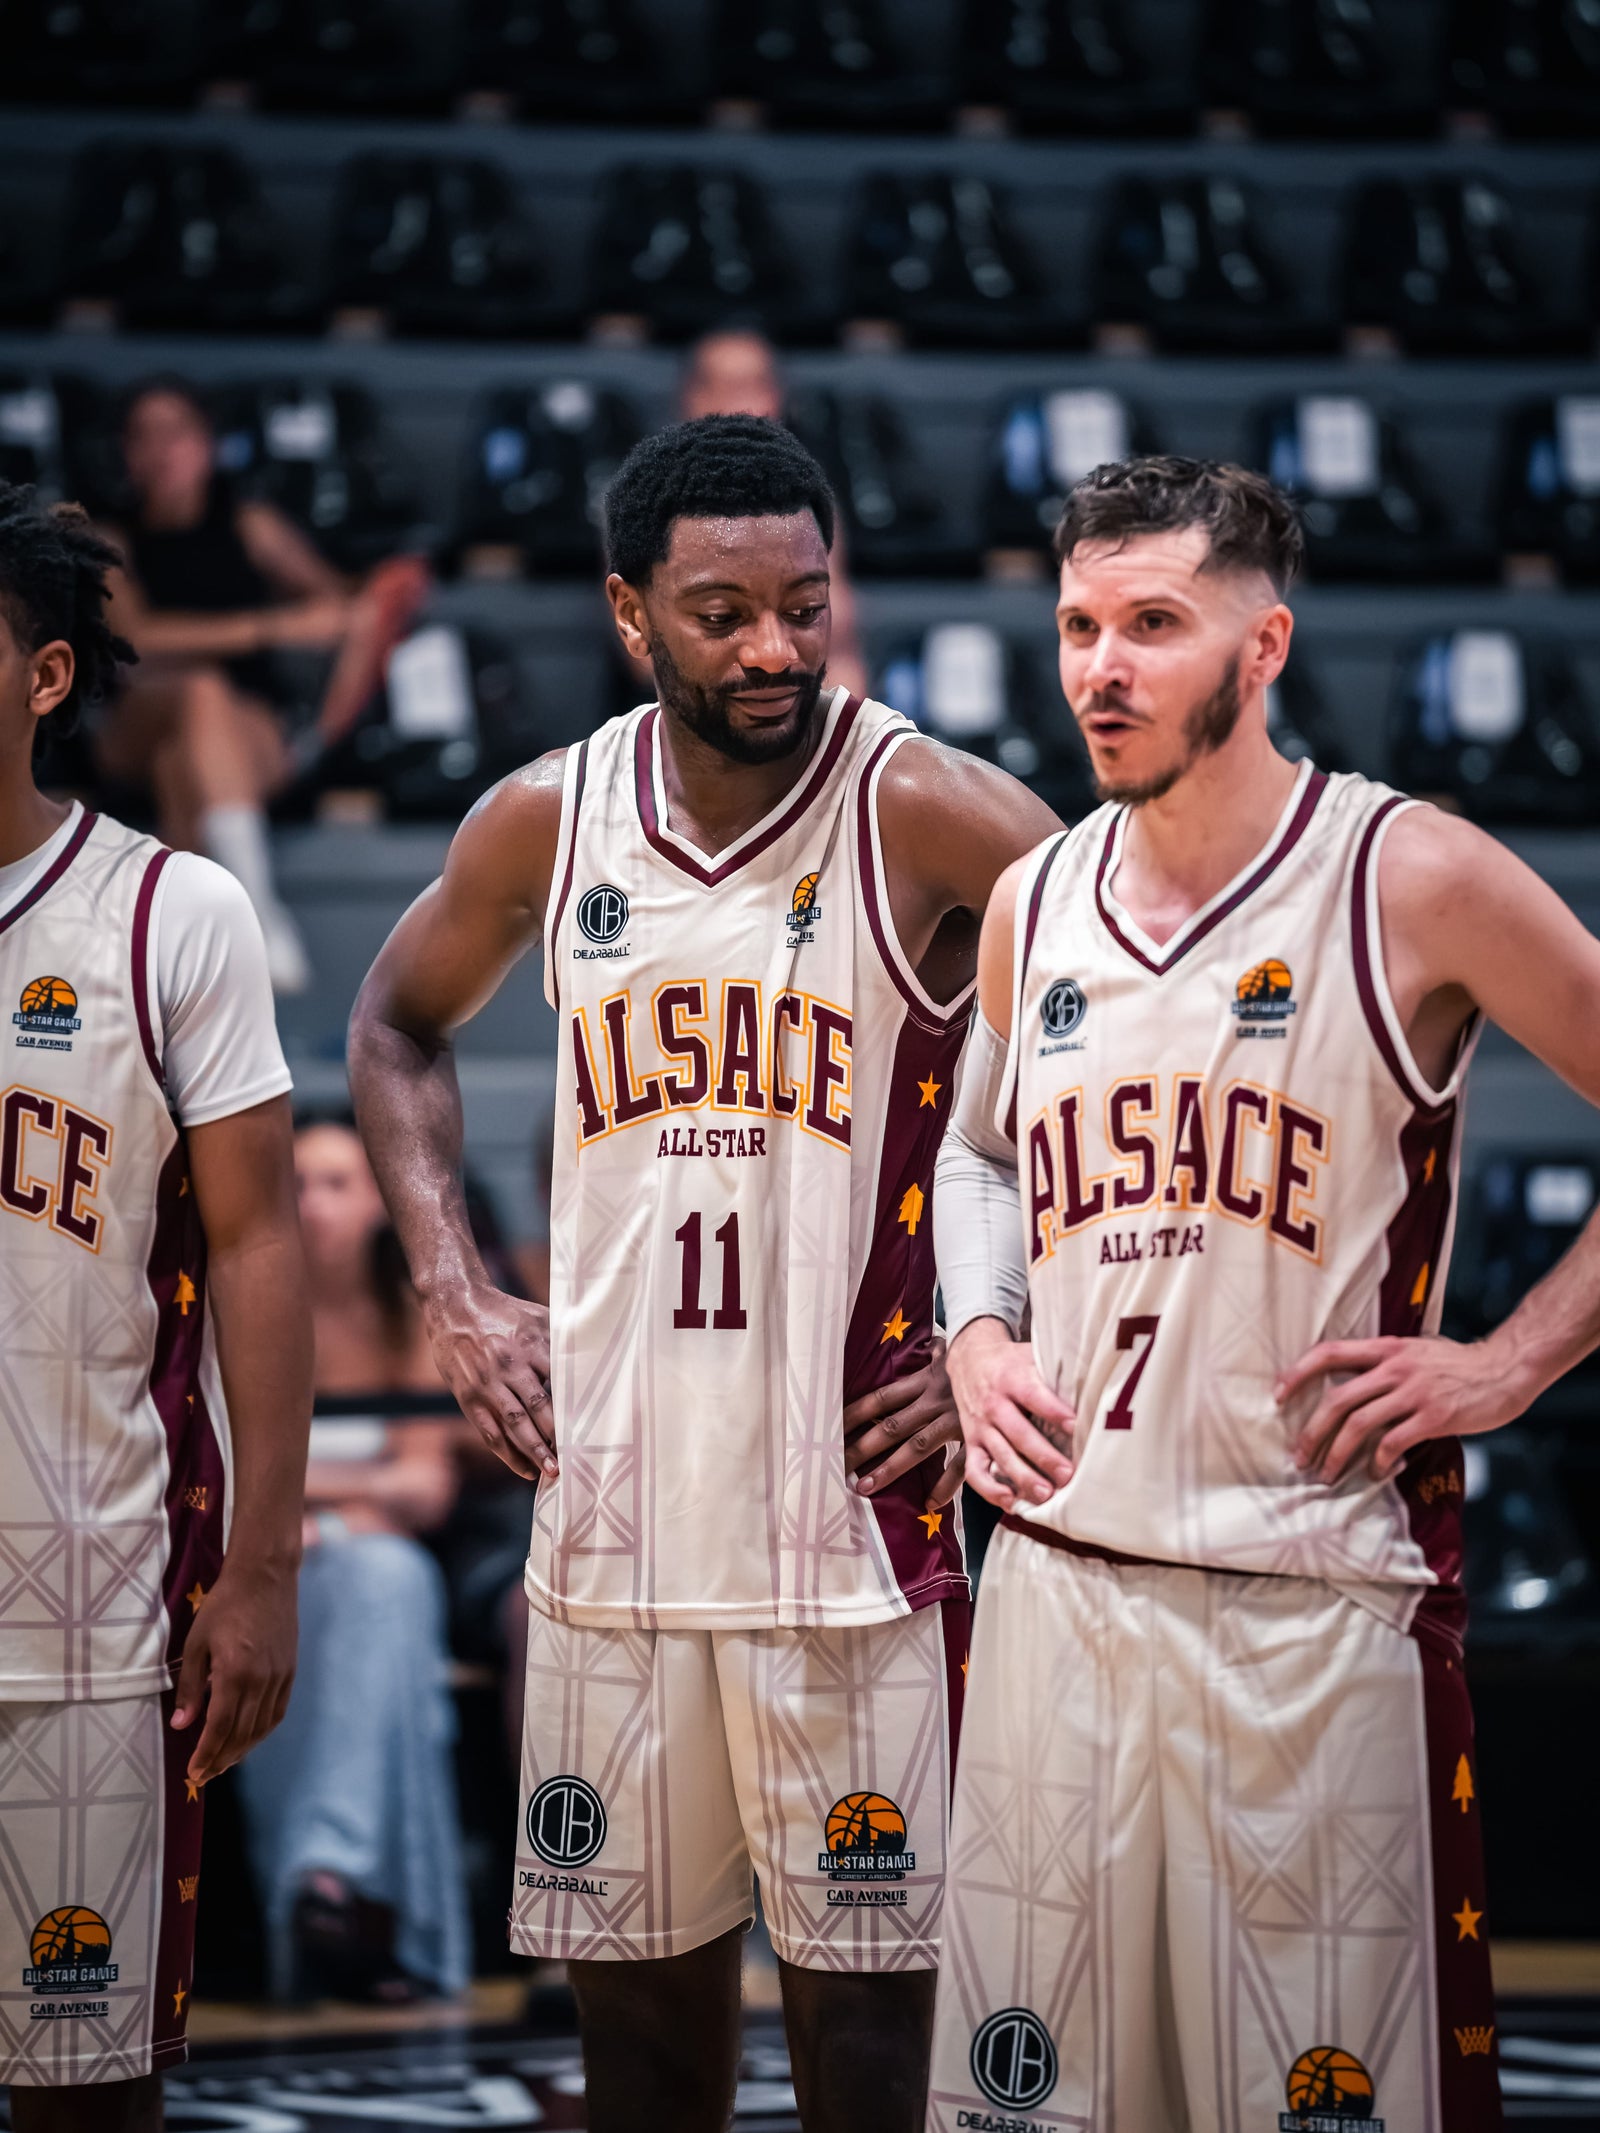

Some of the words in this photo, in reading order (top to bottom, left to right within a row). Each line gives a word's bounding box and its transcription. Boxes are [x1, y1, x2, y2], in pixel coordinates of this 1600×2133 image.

[573, 946, 630, 960] DEARBBALL
[14, 1015, 27, 1024] ALL
[32, 1015, 53, 1026] STAR
[54, 1018, 80, 1029] GAME
[16, 1035, 36, 1045] CAR
[37, 1038, 73, 1049] AVENUE
[657, 1128, 703, 1158] ALL
[706, 1127, 767, 1157] STAR
[1027, 1073, 1332, 1270] ALSACE
[1099, 1232, 1142, 1265] ALL
[1149, 1224, 1204, 1258] STAR
[673, 1211, 748, 1330] 11
[1104, 1315, 1161, 1430] 7
[820, 1855, 840, 1869] ALL
[843, 1855, 875, 1870] STAR
[877, 1854, 914, 1869] GAME
[519, 1871, 608, 1896] DEARBBALL
[826, 1889, 854, 1902] CAR
[856, 1890, 908, 1902] AVENUE
[24, 1970, 42, 1983] ALL
[46, 1969, 78, 1983] STAR
[80, 1966, 117, 1981] GAME
[30, 2003, 55, 2015] CAR
[58, 2001, 109, 2014] AVENUE
[1307, 2116, 1340, 2132] STAR
